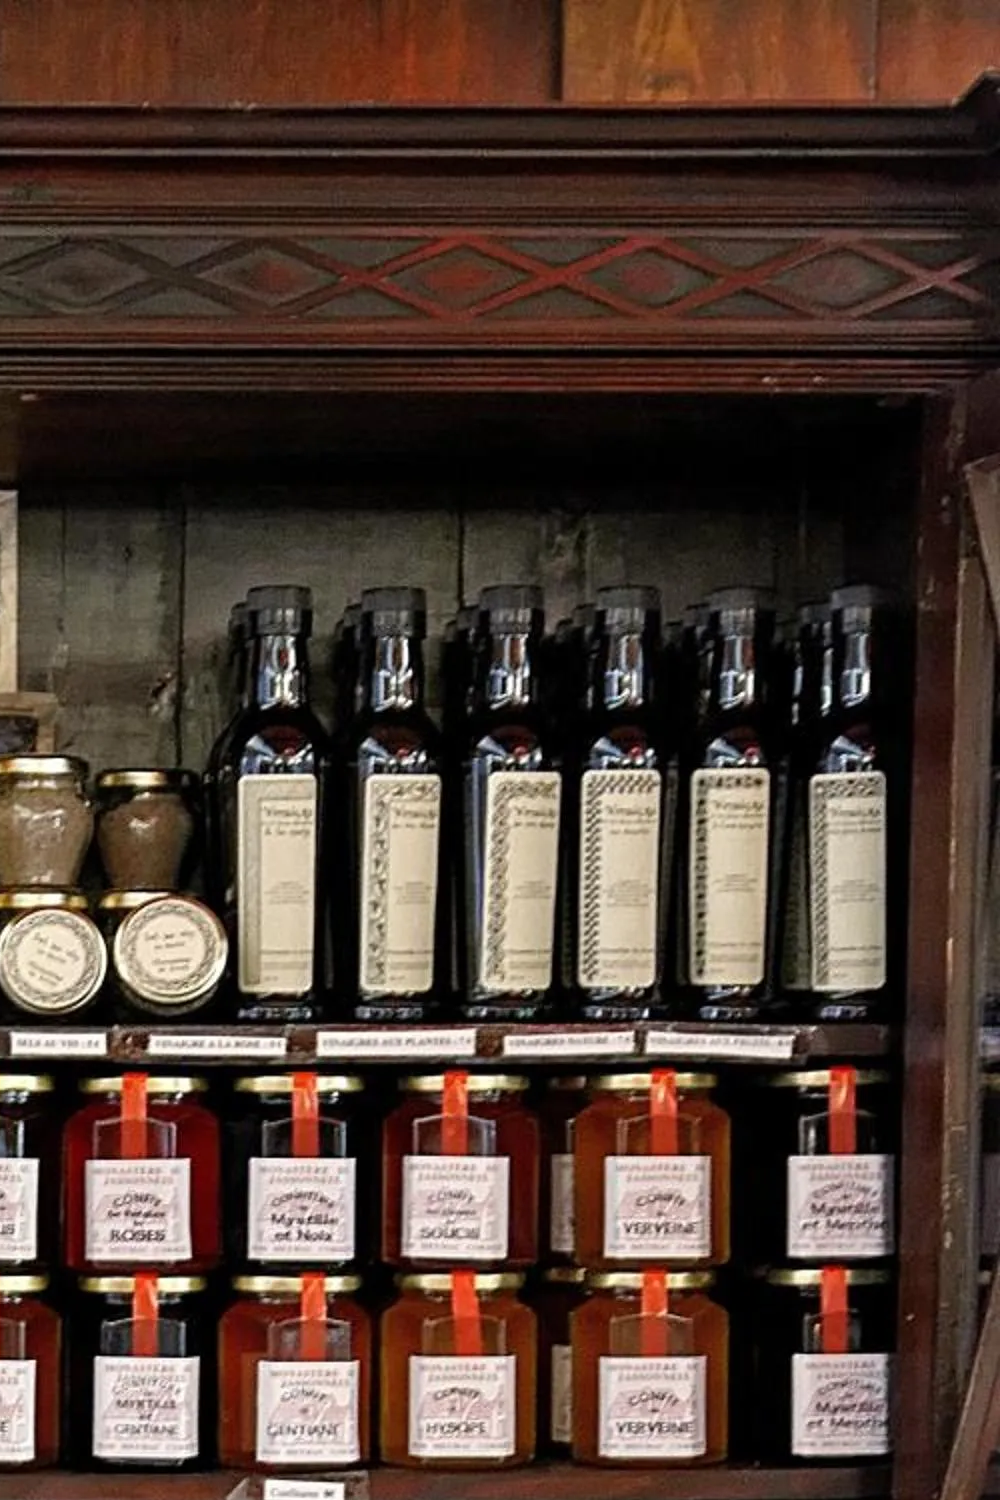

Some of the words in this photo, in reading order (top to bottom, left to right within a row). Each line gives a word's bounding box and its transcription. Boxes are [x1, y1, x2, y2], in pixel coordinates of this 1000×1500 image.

[622, 1221, 698, 1235] VERVEINE
[109, 1229, 167, 1242] ROSES
[266, 1422, 342, 1437] GENTIANE
[425, 1421, 487, 1435] HYSOPE
[615, 1421, 695, 1435] VERVEINE
